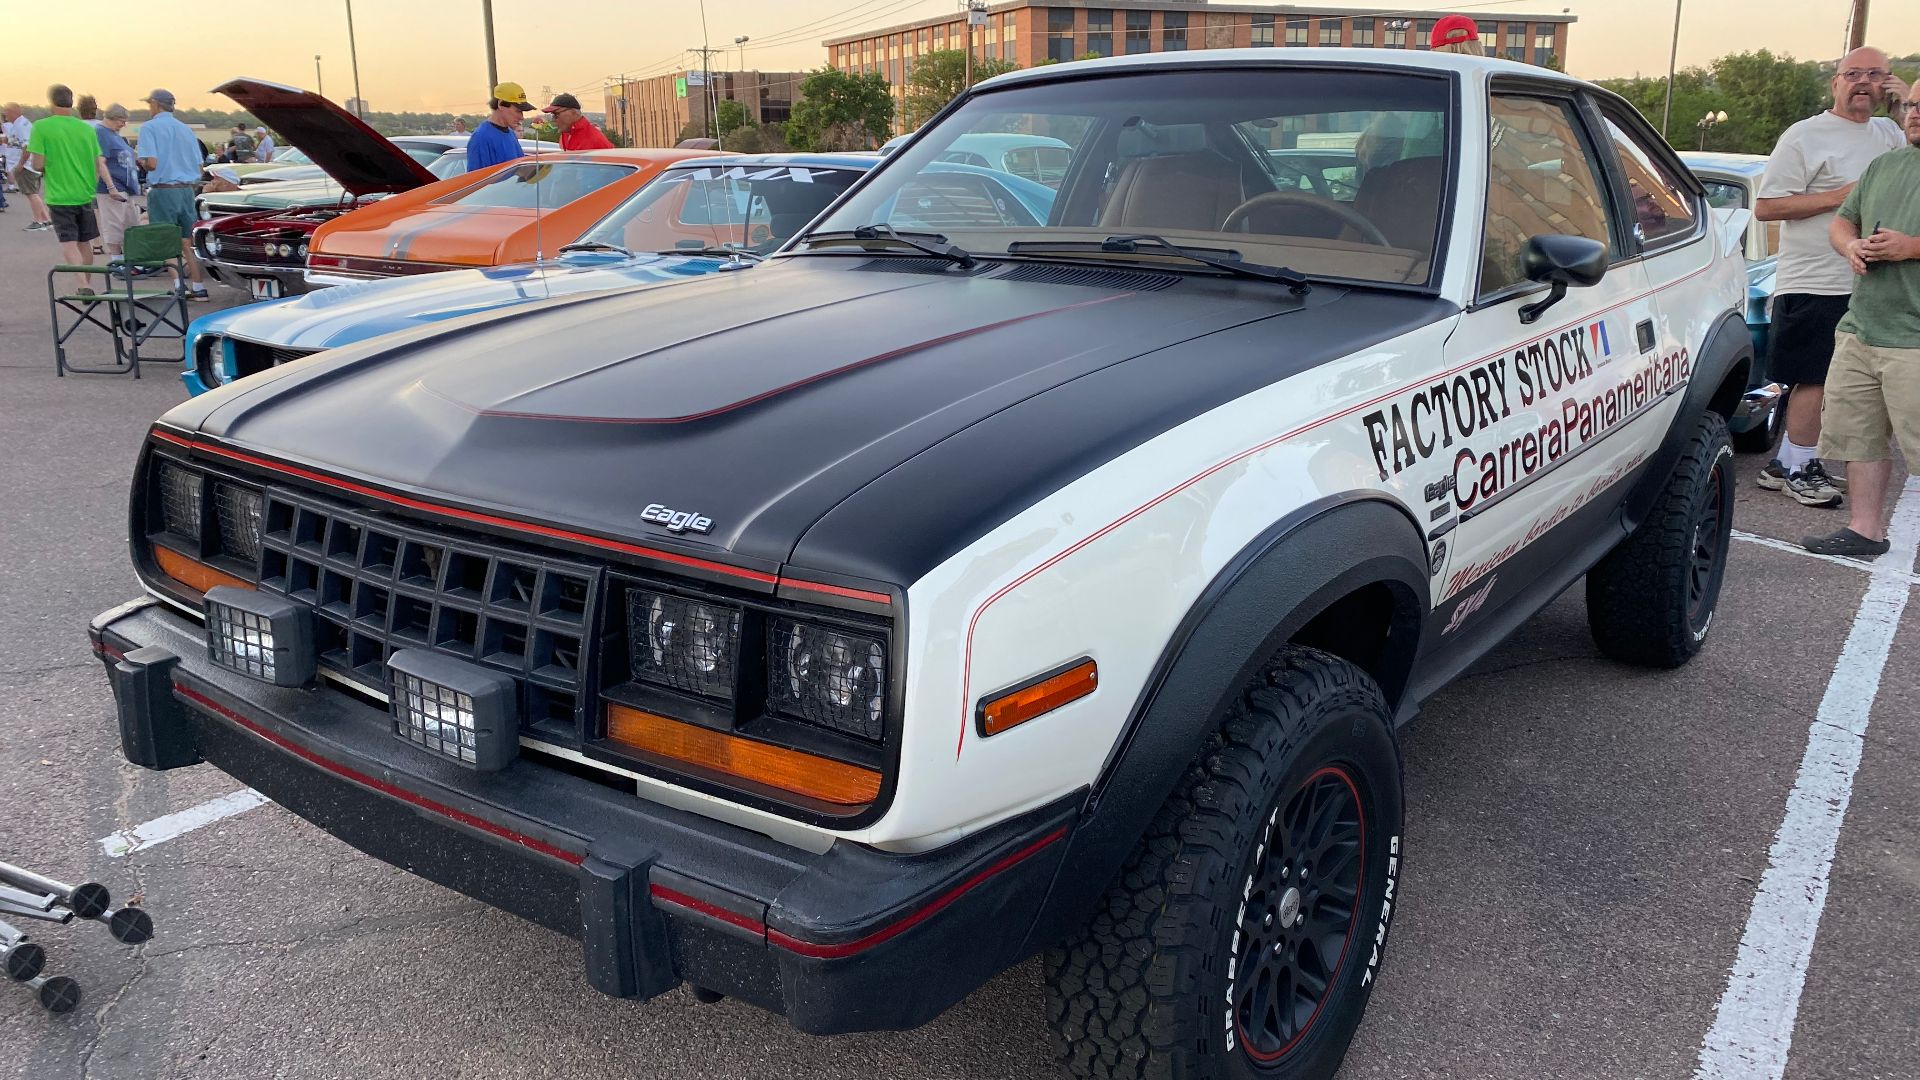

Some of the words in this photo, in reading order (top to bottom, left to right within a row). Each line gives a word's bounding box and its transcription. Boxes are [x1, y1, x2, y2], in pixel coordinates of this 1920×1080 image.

[1362, 357, 1510, 482] FACTORY
[1515, 326, 1593, 407] STOCK
[640, 503, 714, 533] Eagle
[1424, 475, 1457, 503] Eagle
[1443, 540, 1520, 600] Mexican
[1523, 504, 1568, 546] border
[1570, 492, 1584, 512] to
[1586, 465, 1622, 501] border
[1225, 875, 1252, 1051] GRABBER
[1362, 836, 1399, 987] GENERAL
